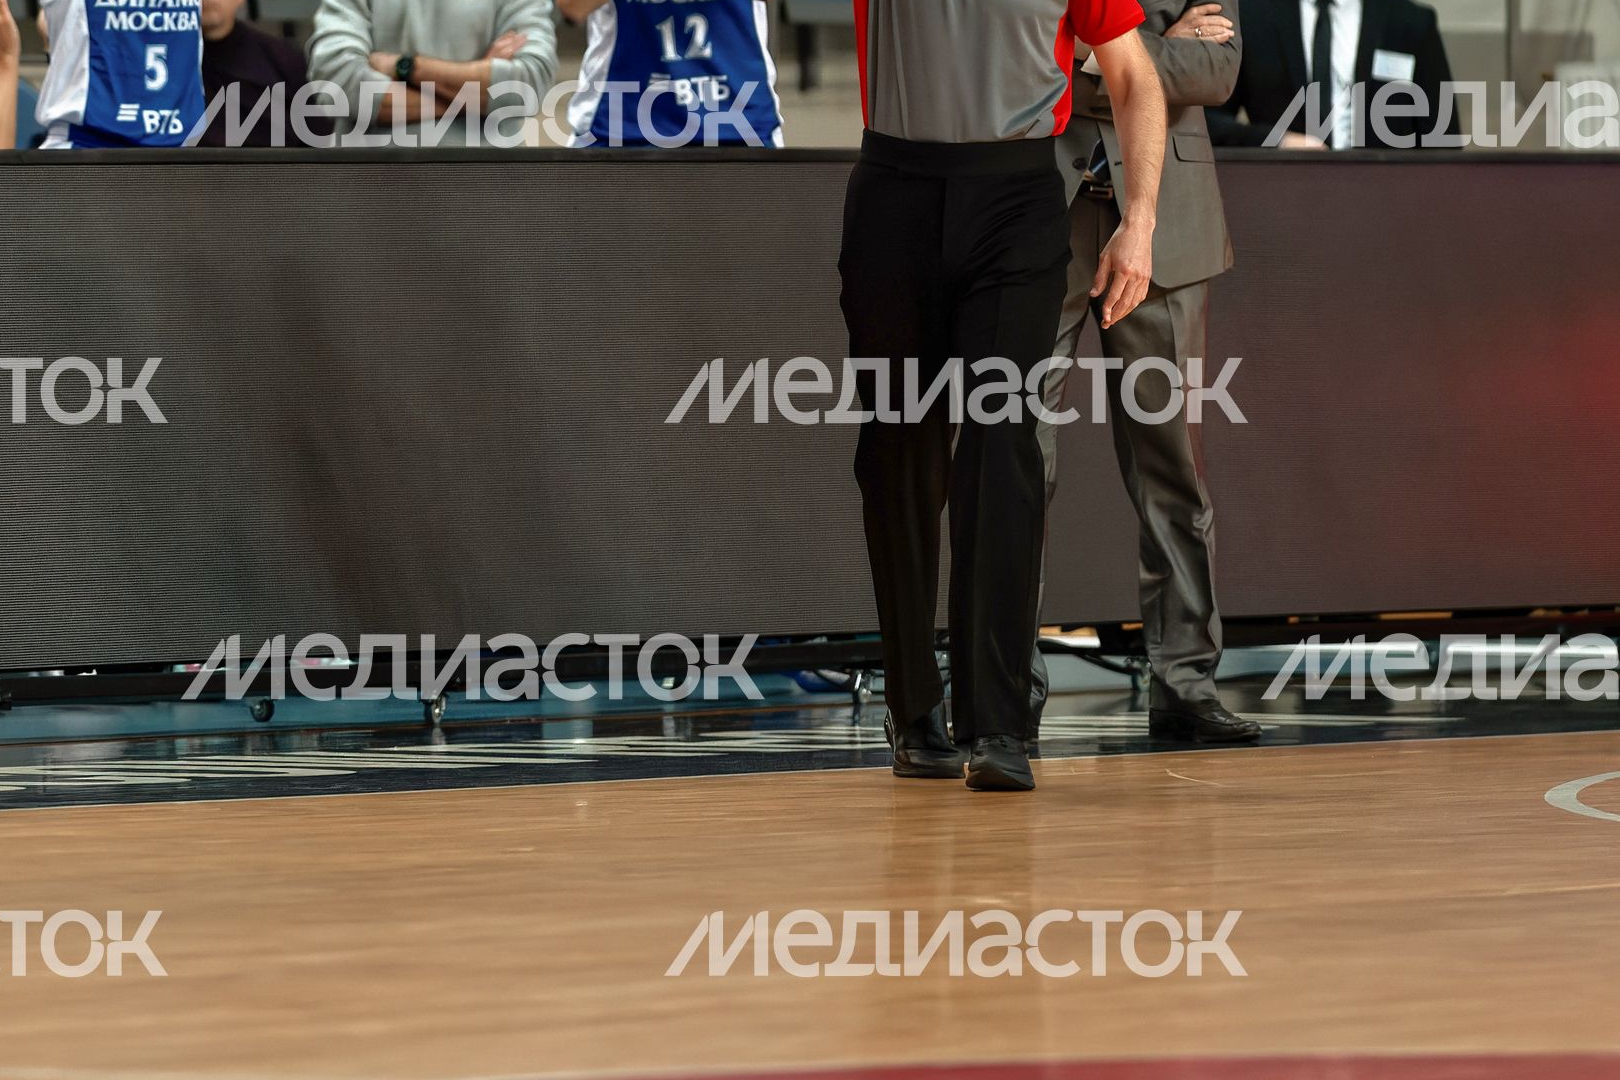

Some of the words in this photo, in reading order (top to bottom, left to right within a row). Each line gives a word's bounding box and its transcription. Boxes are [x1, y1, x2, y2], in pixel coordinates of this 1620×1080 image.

[104, 10, 199, 32] МОСКВА
[655, 14, 713, 62] 12
[144, 43, 168, 91] 5
[675, 75, 730, 106] ВТБ
